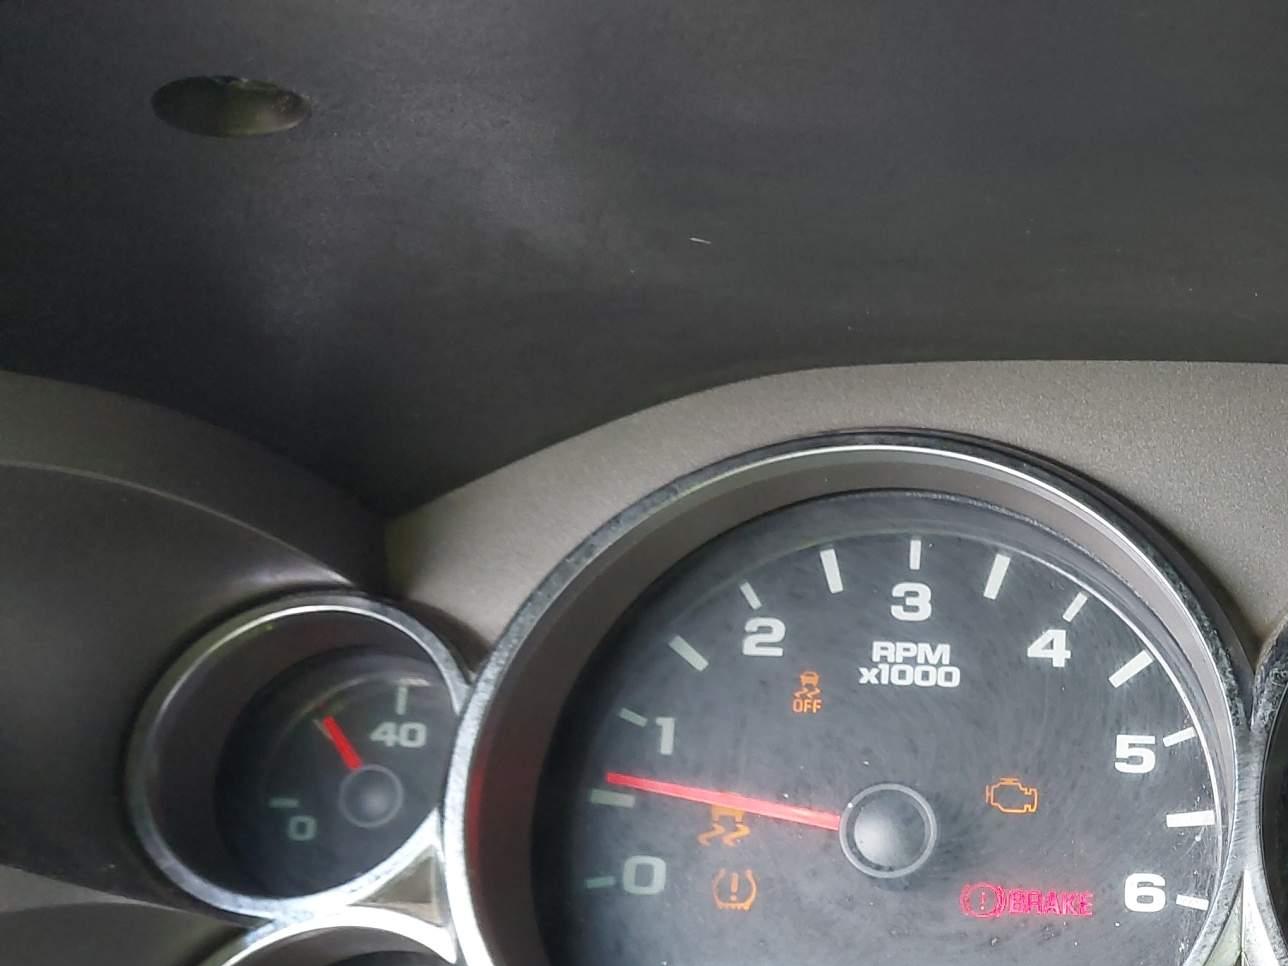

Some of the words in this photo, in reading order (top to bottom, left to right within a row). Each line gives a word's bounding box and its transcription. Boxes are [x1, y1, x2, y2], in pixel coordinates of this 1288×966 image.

[890, 583, 932, 621] 3
[743, 618, 786, 657] 2
[871, 642, 951, 664] RPM
[1027, 629, 1071, 668] 4
[859, 664, 960, 688] x1000
[792, 698, 822, 714] OFF
[371, 721, 428, 749] 40
[655, 717, 676, 755] 1
[1114, 734, 1156, 774] 5
[288, 816, 317, 842] 0
[622, 855, 667, 895] 0
[1124, 873, 1168, 913] 6
[1008, 888, 1093, 915] BRAKE
